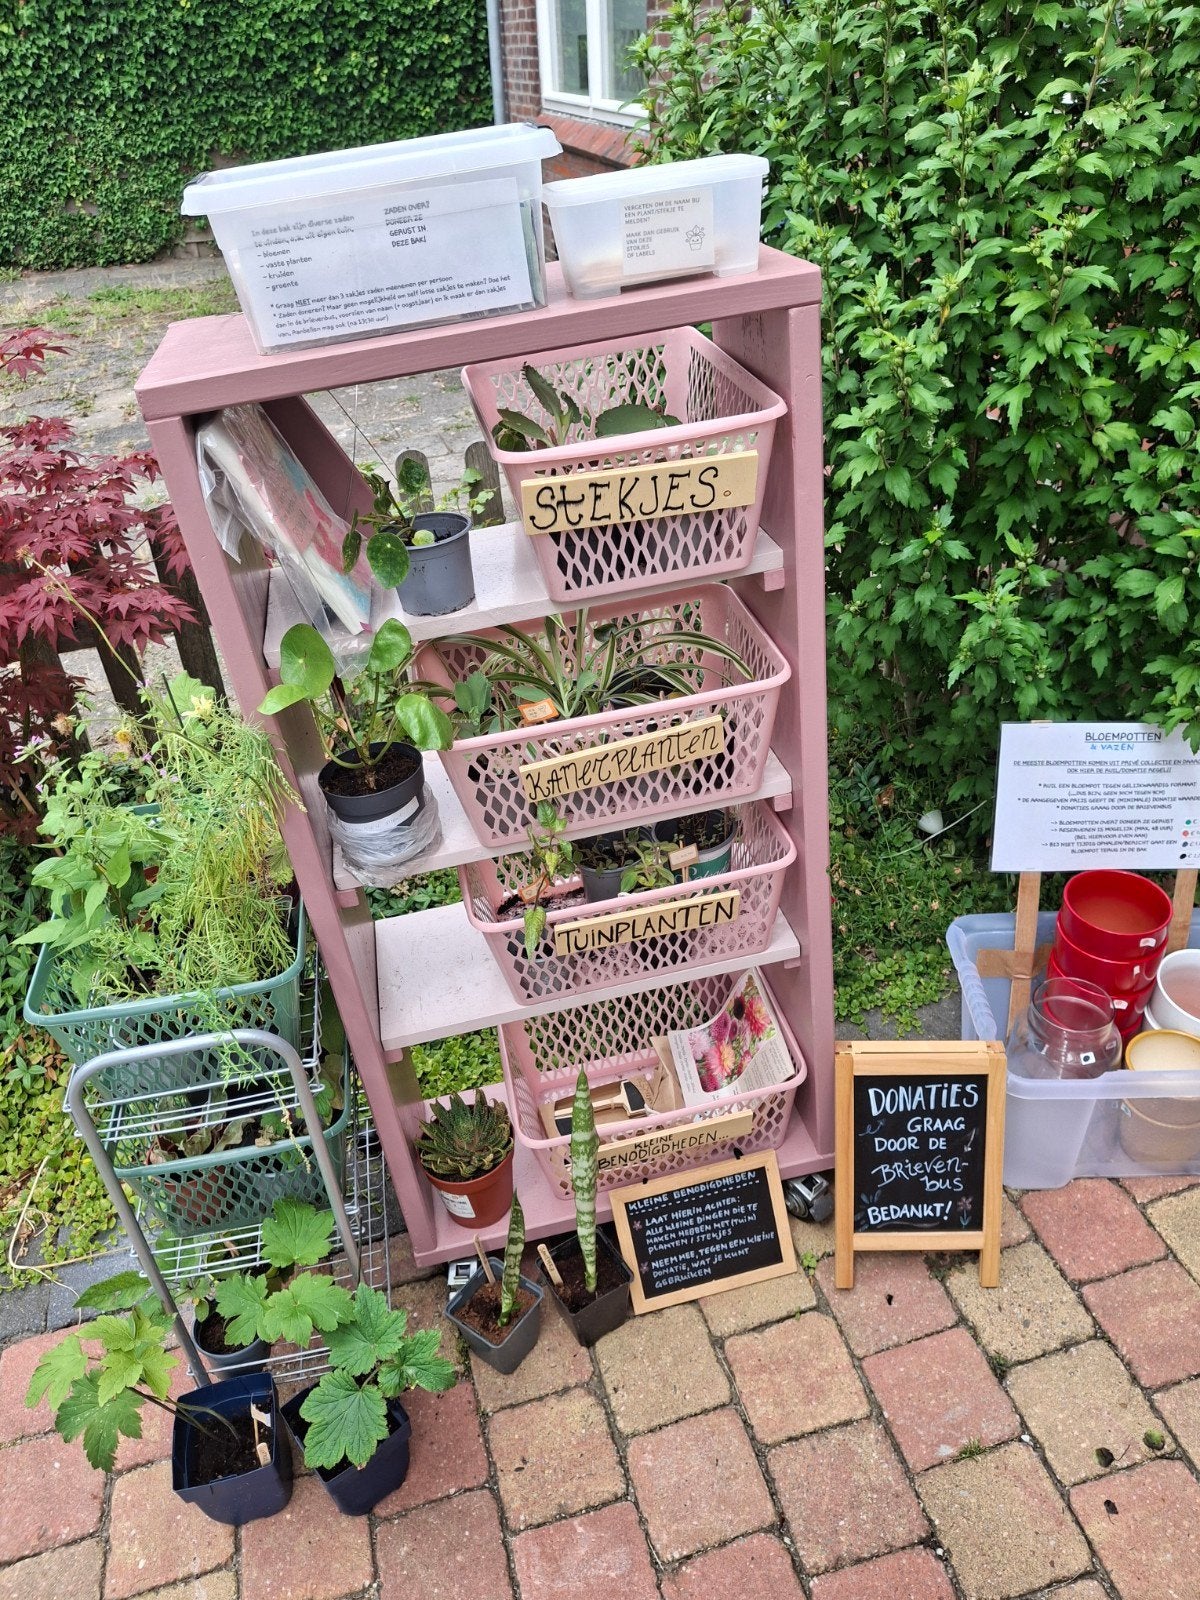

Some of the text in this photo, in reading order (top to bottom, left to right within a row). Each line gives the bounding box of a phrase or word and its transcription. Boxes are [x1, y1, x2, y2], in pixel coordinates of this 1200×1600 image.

[384, 206, 407, 215] ZADEN
[624, 203, 653, 212] VERGETEN
[390, 224, 426, 237] GERUST IN
[391, 235, 427, 248] DEZE BAK!
[263, 248, 291, 257] bloemen
[265, 256, 313, 269] vaste planten
[268, 270, 295, 279] kruiden
[271, 280, 299, 291] groente
[295, 298, 311, 307] NIET
[1085, 731, 1162, 741] BLOEMPOTTEN
[1100, 743, 1135, 751] VAZEN
[907, 1116, 966, 1133] GRAAG
[874, 1136, 947, 1153] DOOR DE
[747, 1202, 759, 1212] TE
[867, 1200, 953, 1226] BEDANKT!
[645, 1213, 669, 1227] LAAT
[651, 1256, 678, 1270] NEEM
